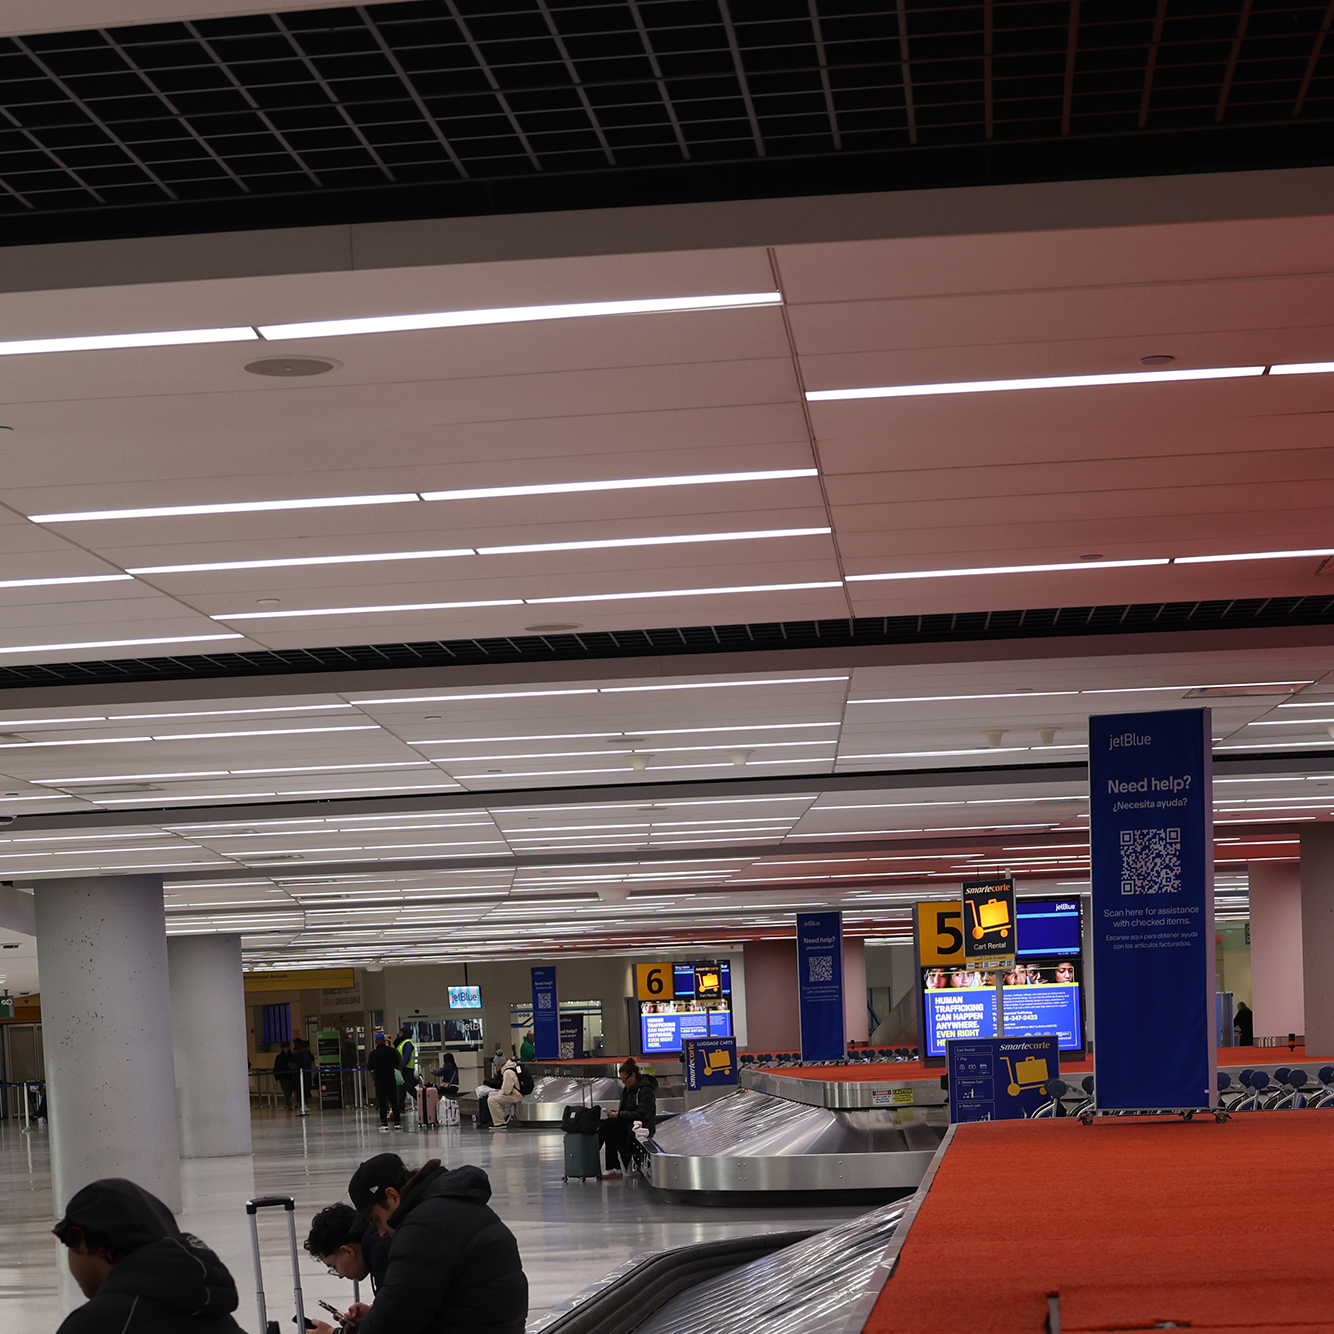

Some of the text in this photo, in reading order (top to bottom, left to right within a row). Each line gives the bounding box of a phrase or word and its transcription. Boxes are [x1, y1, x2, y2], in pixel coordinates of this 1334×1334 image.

[1109, 733, 1152, 751] jetBlue
[1108, 775, 1192, 794] Need help?
[1112, 797, 1188, 813] ¿Necesita ayuda?
[1055, 903, 1076, 912] jetBlue
[1103, 906, 1199, 918] Scan here for assistance
[1113, 917, 1191, 928] with checked items.
[937, 912, 963, 955] 5
[820, 935, 835, 944] help?
[974, 941, 1007, 951] Cart Rental
[646, 968, 663, 995] 6
[451, 991, 477, 1004] jetBlue
[935, 996, 963, 1005] HUMAN
[935, 1003, 984, 1013] TRAFFICKING
[935, 1012, 983, 1021] CAN HAPPEN
[936, 1021, 980, 1030] ANYWHERE.
[936, 1029, 980, 1038] EVEN RIGHT
